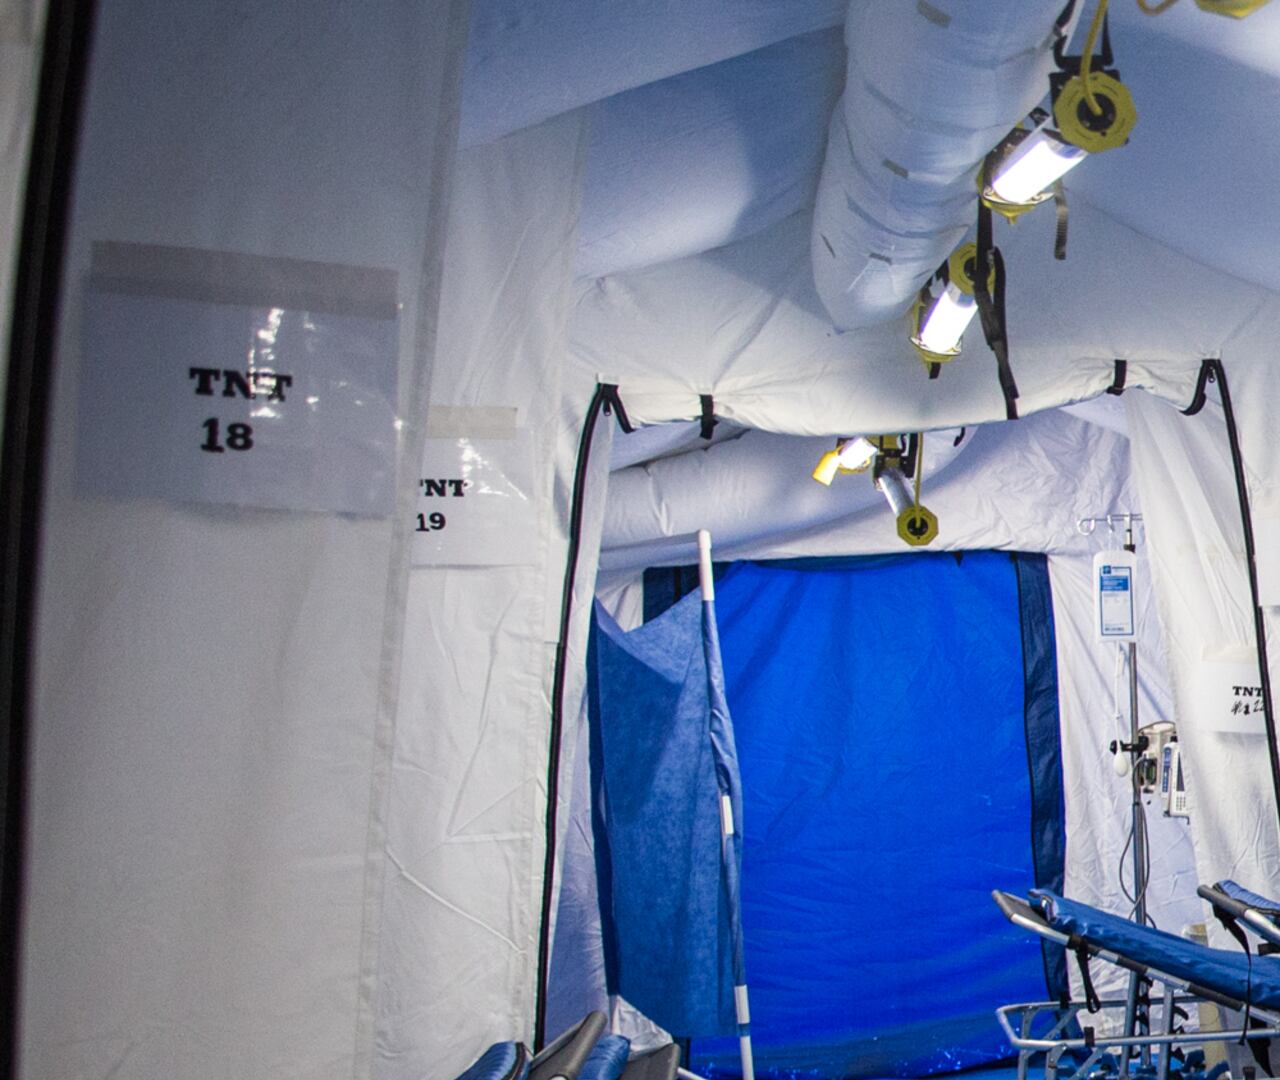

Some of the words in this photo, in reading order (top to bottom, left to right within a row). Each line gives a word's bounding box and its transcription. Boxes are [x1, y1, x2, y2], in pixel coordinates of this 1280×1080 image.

[189, 366, 293, 402] TNT
[201, 418, 254, 453] 18
[419, 478, 468, 498] NT
[415, 512, 446, 532] 19
